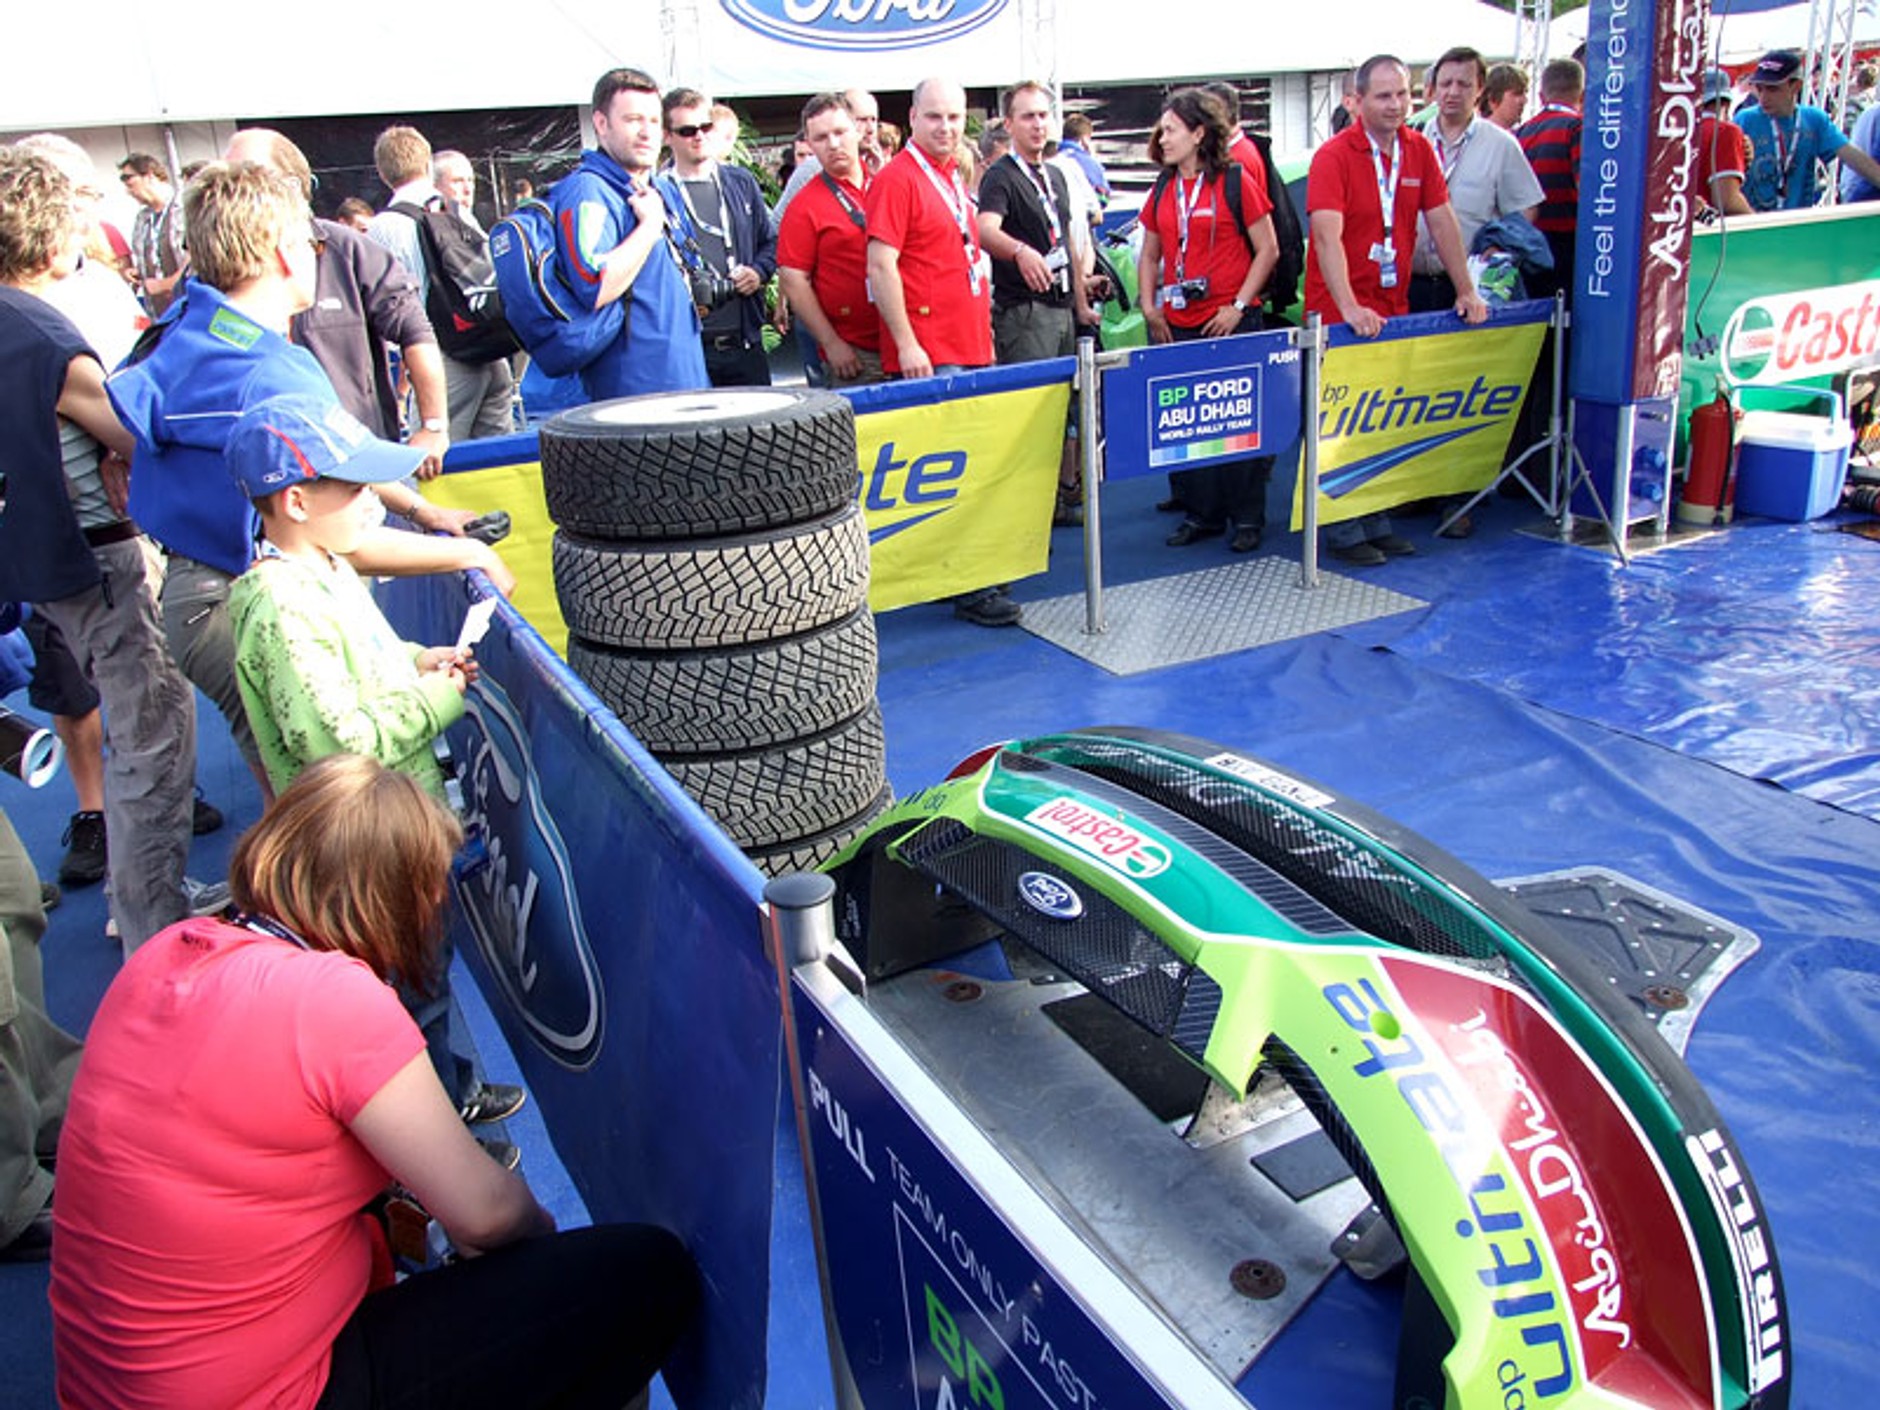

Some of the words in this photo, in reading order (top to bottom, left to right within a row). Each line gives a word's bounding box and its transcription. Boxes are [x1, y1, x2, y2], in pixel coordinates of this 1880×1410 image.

[1593, 159, 1618, 217] the
[1588, 226, 1614, 297] Feel
[1268, 350, 1299, 366] PUSH
[1157, 386, 1189, 407] BP
[1193, 376, 1253, 402] FORD
[1157, 406, 1195, 430] ABU
[1199, 397, 1252, 423] DHABI
[1319, 375, 1521, 440] ultimate
[1322, 383, 1349, 405] bp
[1158, 427, 1194, 442] WORLD
[1196, 423, 1224, 436] RALLY
[1226, 418, 1252, 431] TEAM
[854, 441, 967, 511] te
[1037, 801, 1141, 857] Castrol
[1026, 876, 1069, 907] Ford
[808, 1067, 876, 1183] PULL
[885, 1146, 948, 1243] TEAM
[951, 1230, 1015, 1322] ONLY
[1021, 1314, 1097, 1410] PAST
[924, 1283, 1005, 1410] BP
